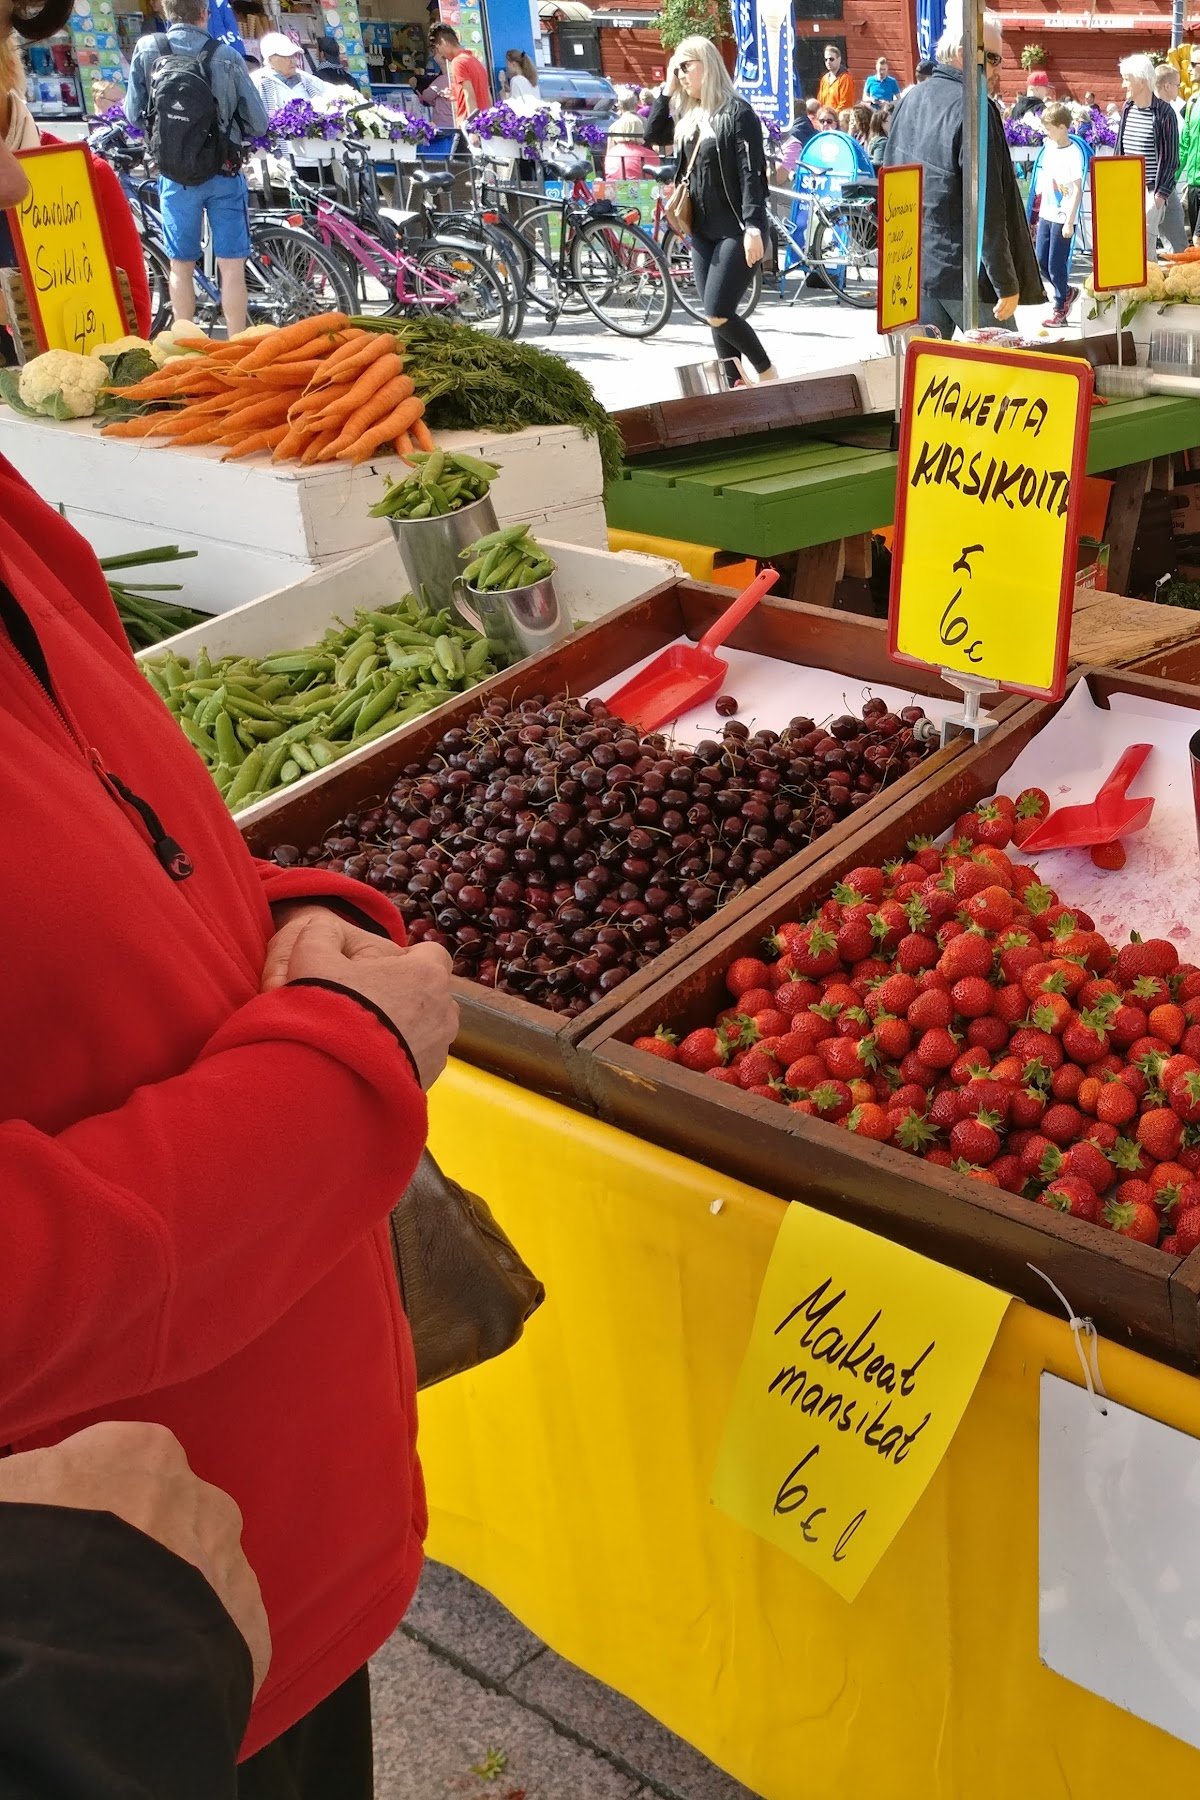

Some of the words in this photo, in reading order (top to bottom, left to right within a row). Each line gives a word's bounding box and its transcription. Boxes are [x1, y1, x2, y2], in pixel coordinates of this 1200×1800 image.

[918, 374, 1048, 438] MAKEITA
[774, 1276, 936, 1396] Makeat
[767, 1365, 932, 1465] mansikat
